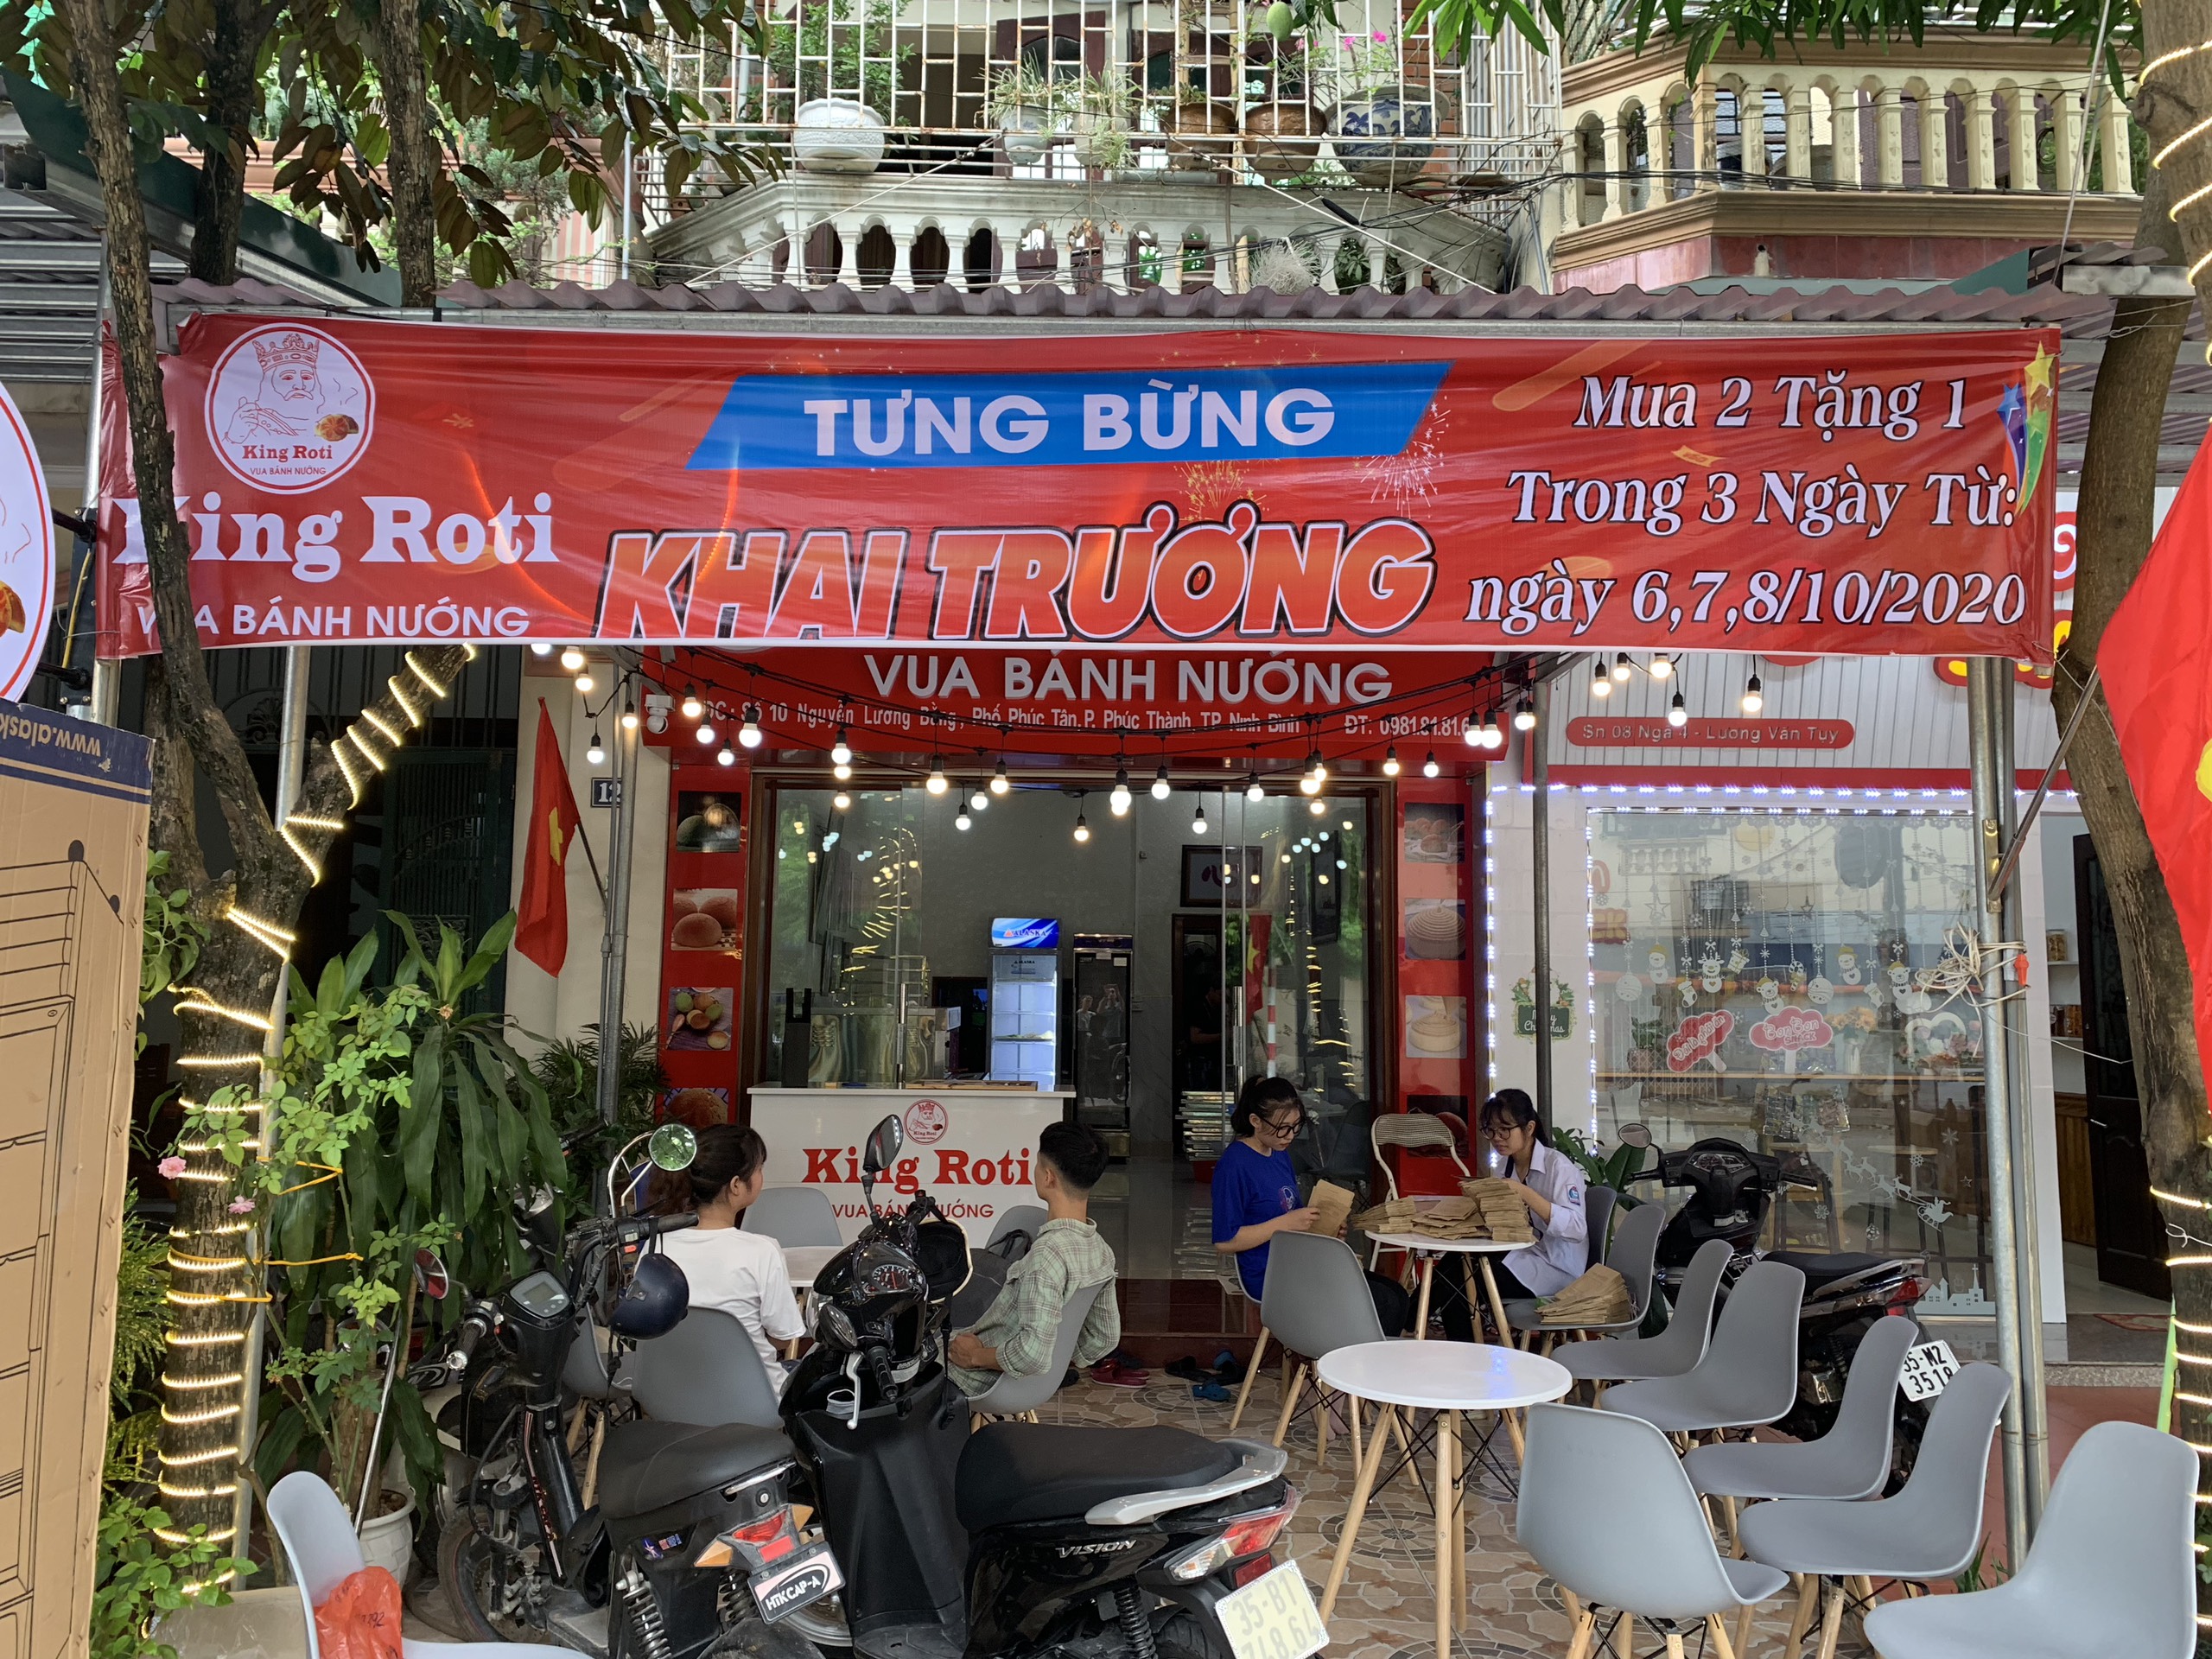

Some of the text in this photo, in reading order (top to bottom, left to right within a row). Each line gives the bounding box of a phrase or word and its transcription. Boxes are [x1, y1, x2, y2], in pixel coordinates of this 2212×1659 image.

[803, 378, 1336, 457] TƯNG BỪNG
[1573, 369, 1967, 442] Mua 2 Tặng 1
[242, 444, 333, 463] King Roti
[270, 465, 292, 475] BÁNH
[295, 465, 327, 475] NƯỚNG
[1508, 463, 2017, 539] Trong 3 Ngày Từ:
[359, 492, 560, 564] Roti
[593, 499, 1437, 641] KHAI TRƯƠNG
[137, 595, 531, 637] VA BÁNH NƯỚNG
[1464, 557, 2028, 637] ngày 6,7,8/10/2020
[864, 649, 1394, 705] VUA BÁNH NƯỚNG
[769, 702, 788, 722] 10
[864, 705, 911, 730] Lương
[972, 703, 1001, 728] Phố
[1008, 707, 1046, 728] Phúc
[1103, 709, 1141, 730] Phúc
[1344, 715, 1372, 734] ĐT:
[1379, 716, 1471, 736] 0981.81.81.6
[1583, 725, 1605, 739] Sn
[932, 1147, 1033, 1185] Roti
[831, 1198, 995, 1218] VUA BÁN ƯỚNG
[1055, 1539, 1137, 1559] VISION
[1232, 1573, 1298, 1637] 35-B1
